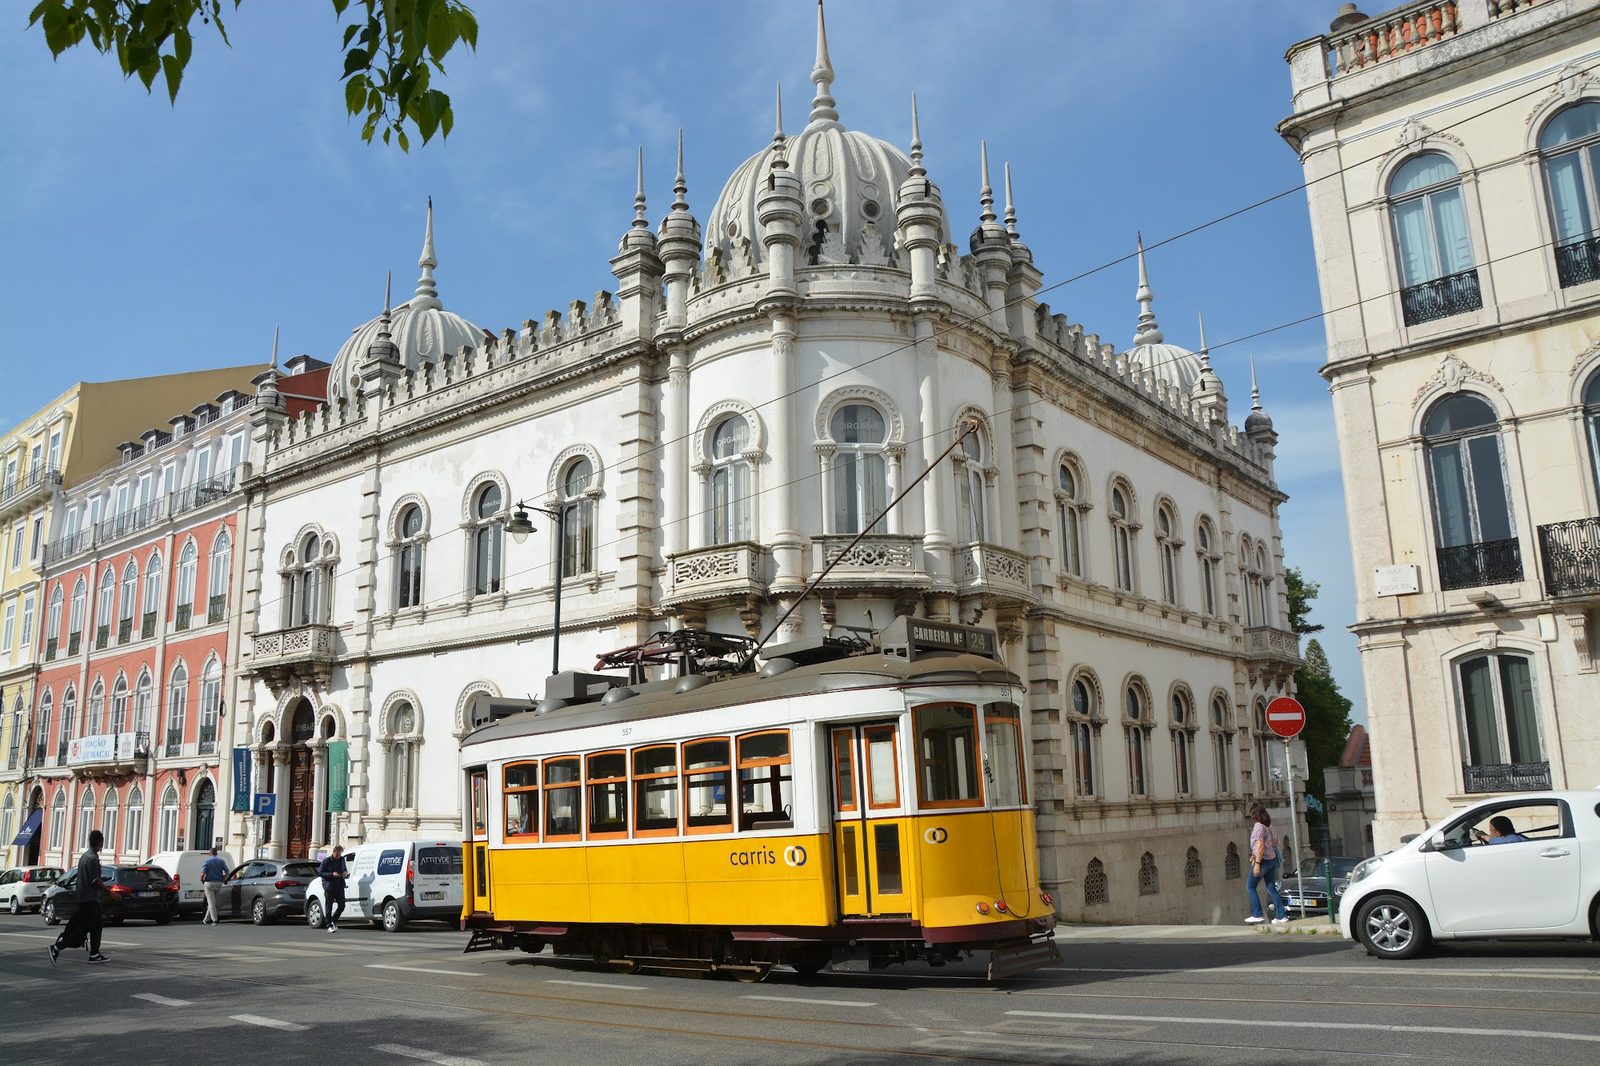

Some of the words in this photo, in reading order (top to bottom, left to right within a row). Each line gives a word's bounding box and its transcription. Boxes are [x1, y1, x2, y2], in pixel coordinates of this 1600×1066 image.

[913, 626, 951, 644] CARREIRA
[971, 633, 985, 650] 24
[1001, 688, 1010, 697] 557
[622, 727, 632, 737] 557
[258, 796, 271, 813] P
[730, 845, 776, 866] carris
